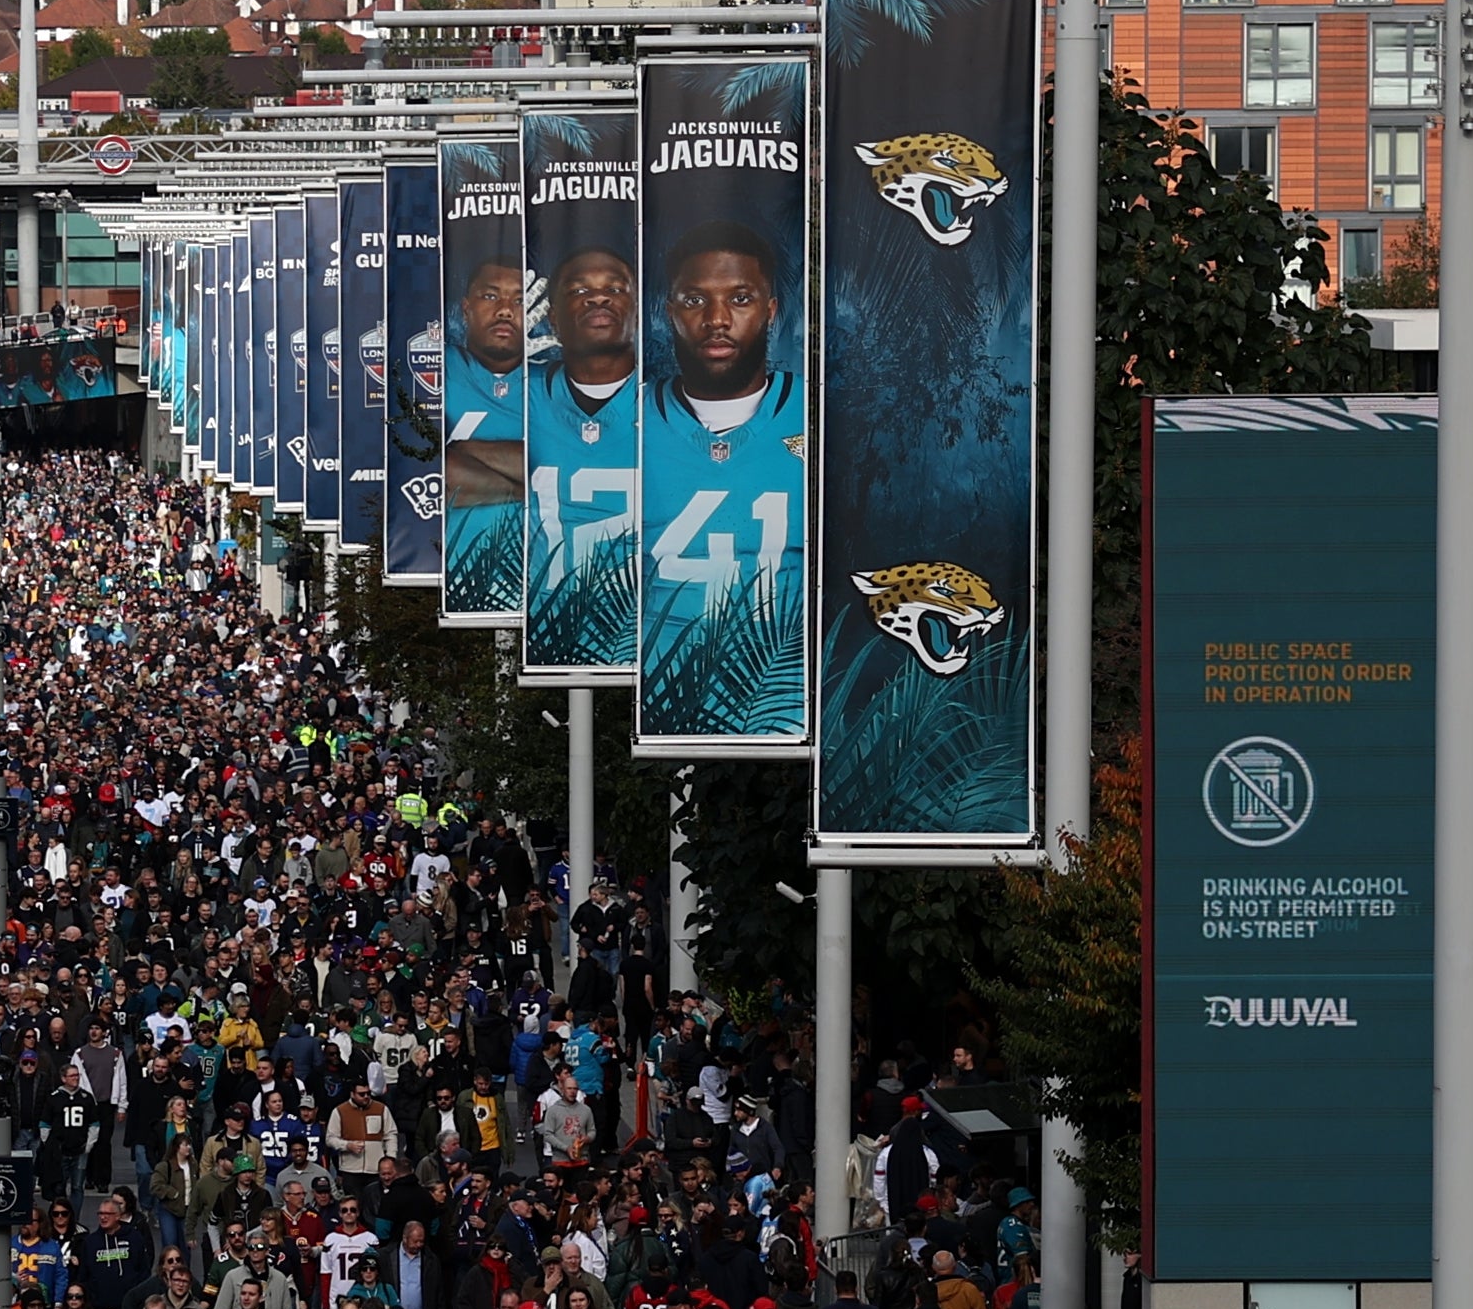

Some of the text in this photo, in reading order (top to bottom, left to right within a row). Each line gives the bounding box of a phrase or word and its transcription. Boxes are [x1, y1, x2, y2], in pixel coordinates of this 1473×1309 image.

[668, 121, 782, 135] JACKSONVILLE
[650, 139, 799, 173] JAGUARS
[544, 161, 639, 174] JACKSONVILLE
[459, 182, 522, 194] JACKSONVI
[530, 176, 638, 205] JAGUAR
[447, 195, 523, 221] JAGUA
[651, 490, 788, 593] 41
[1205, 643, 1353, 661] PUBLIC SPACE
[1205, 663, 1412, 682] PROTECTION ORDER
[1205, 685, 1352, 703] IN OPERATION
[1203, 877, 1409, 896] DRINKING ALCOHOL
[1203, 899, 1395, 917] IS NOT PERMITTED
[1203, 920, 1319, 939] ON-STREET
[1203, 995, 1357, 1027] DUUUVAL
[63, 1105, 84, 1128] 16
